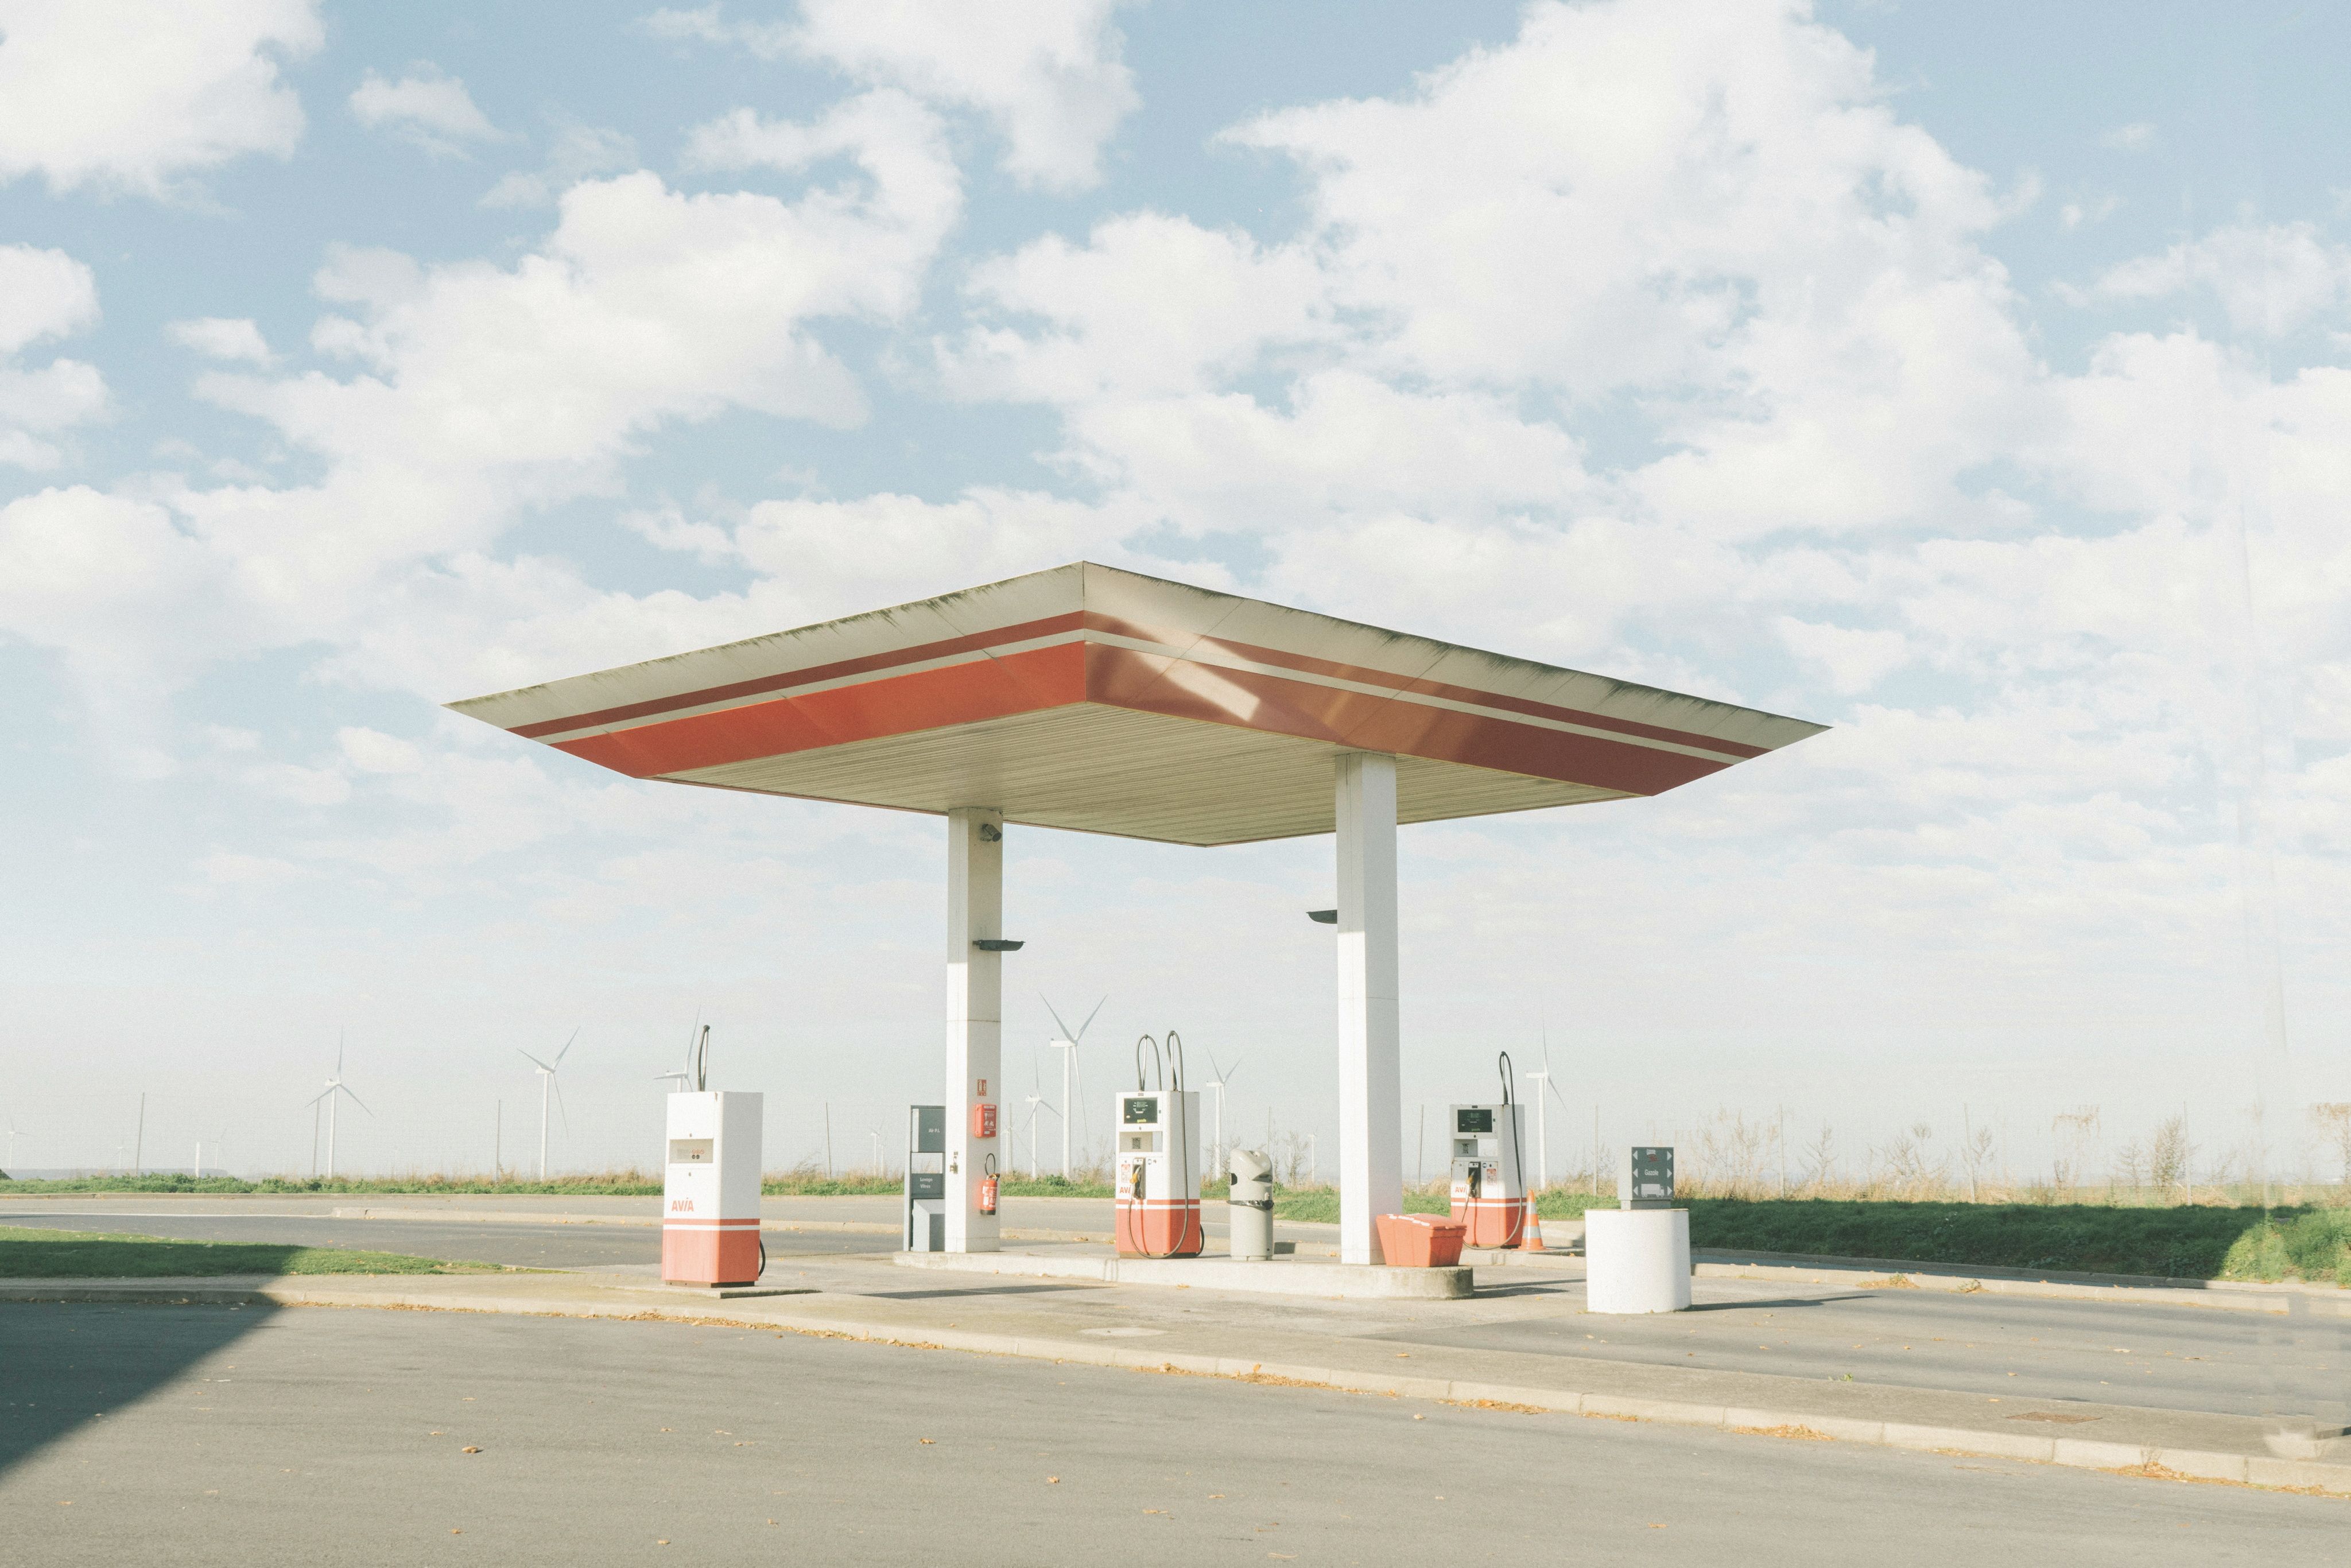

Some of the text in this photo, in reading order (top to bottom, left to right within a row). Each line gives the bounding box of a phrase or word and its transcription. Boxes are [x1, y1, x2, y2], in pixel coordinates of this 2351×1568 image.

[1119, 1185, 1131, 1194] AVI
[1454, 1185, 1467, 1193] AVI
[671, 1197, 695, 1212] AVIA
